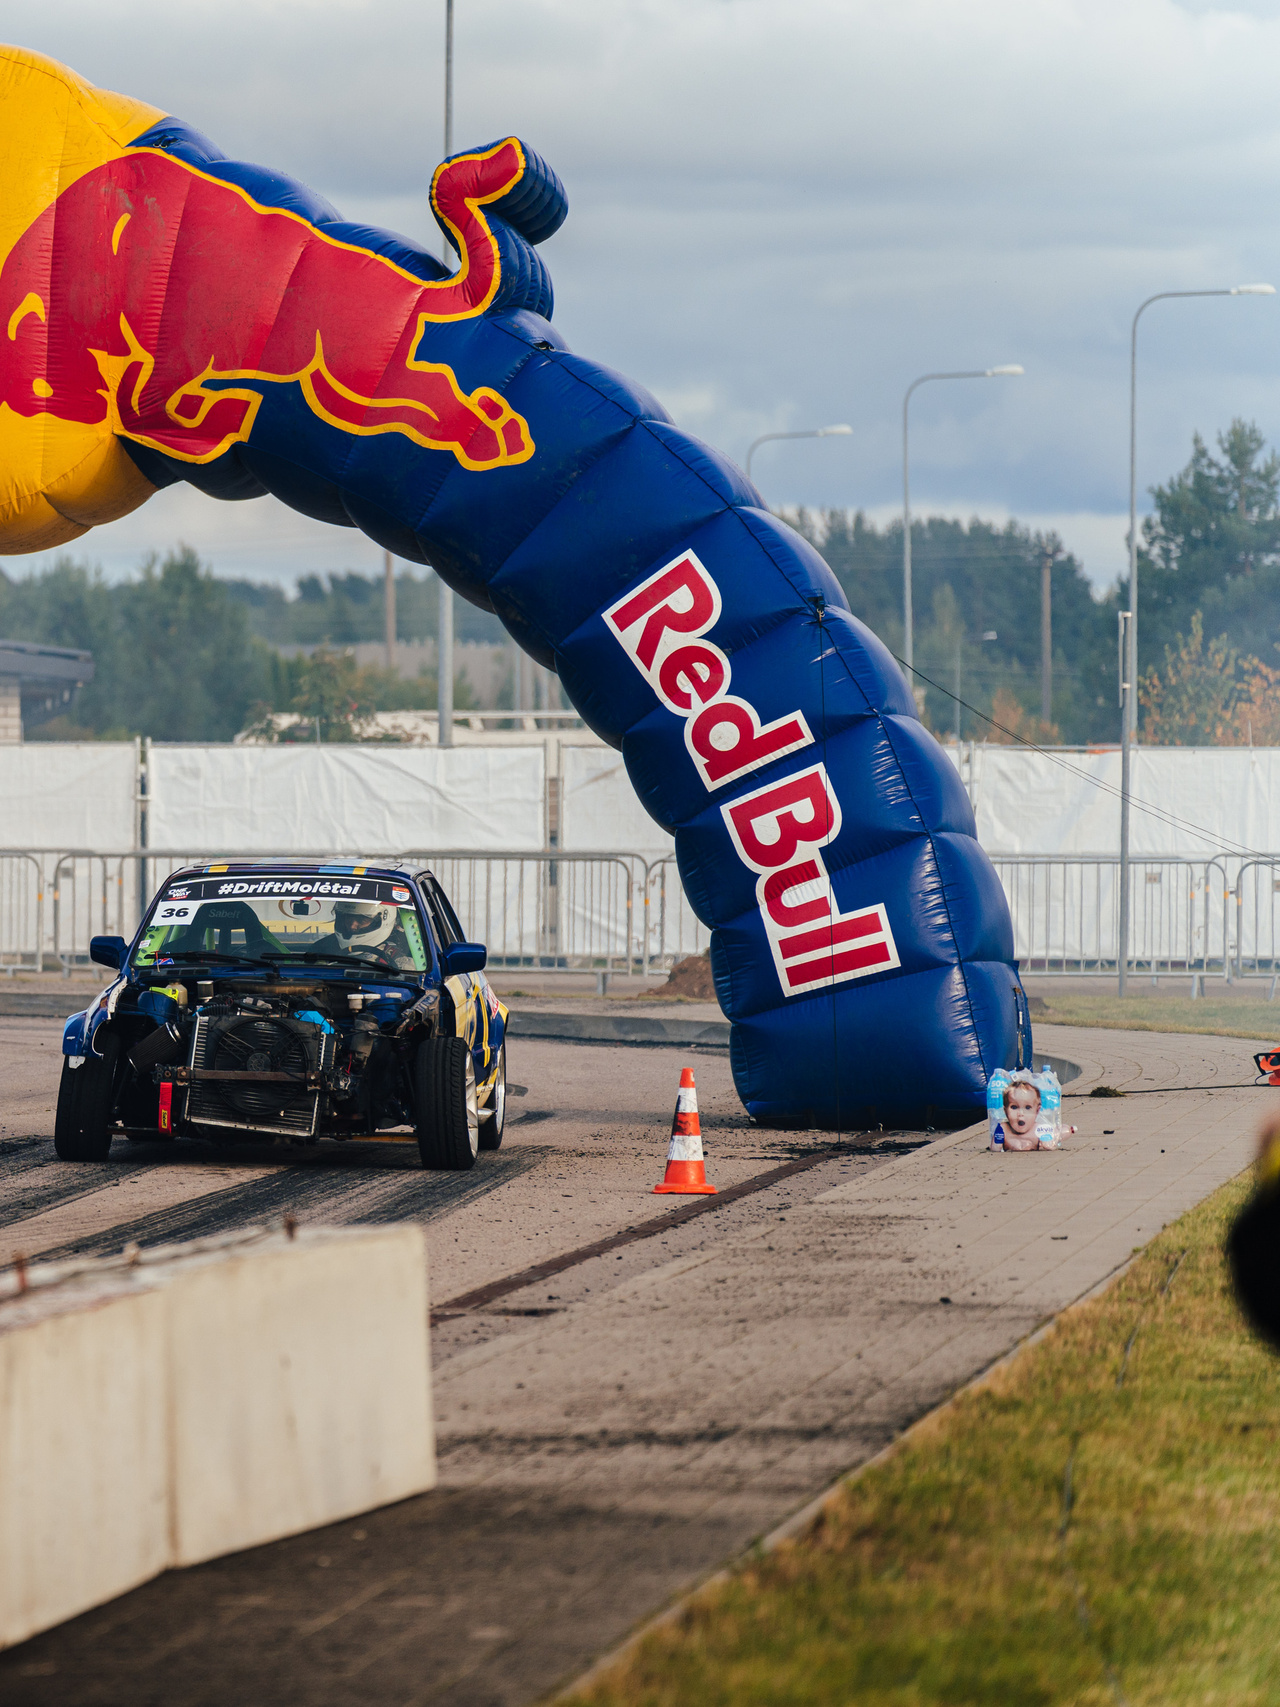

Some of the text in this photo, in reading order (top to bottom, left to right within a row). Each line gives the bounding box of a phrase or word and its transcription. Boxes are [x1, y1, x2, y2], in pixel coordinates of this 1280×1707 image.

[604, 551, 898, 994] Red Bull
[161, 907, 190, 919] 36
